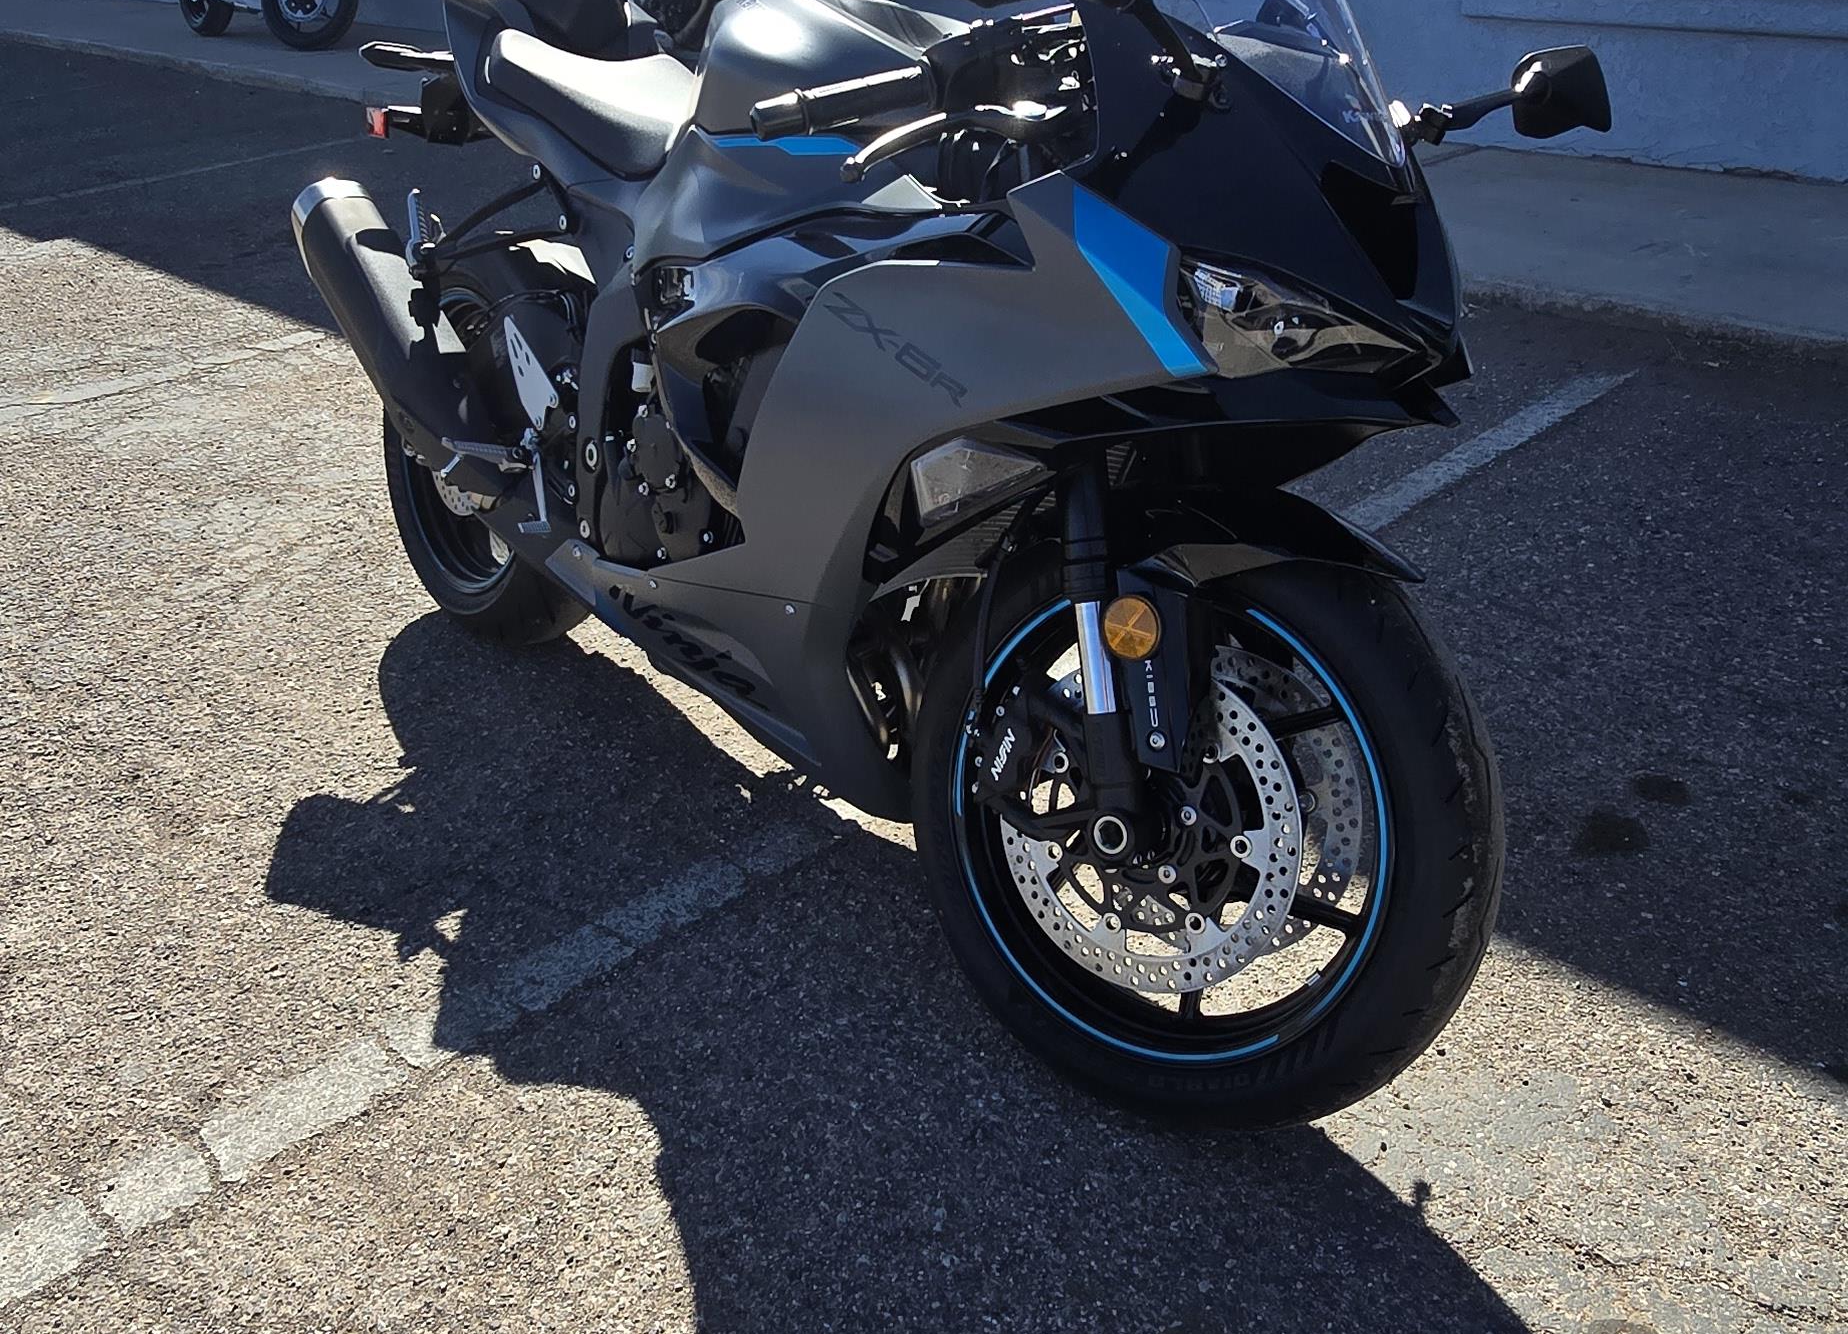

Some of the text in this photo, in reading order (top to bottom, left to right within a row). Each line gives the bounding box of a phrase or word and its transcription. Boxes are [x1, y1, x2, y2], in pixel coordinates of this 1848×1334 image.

[823, 291, 968, 408] ZX-6R
[609, 585, 770, 711] Ninja
[990, 727, 1016, 782] NISSIN
